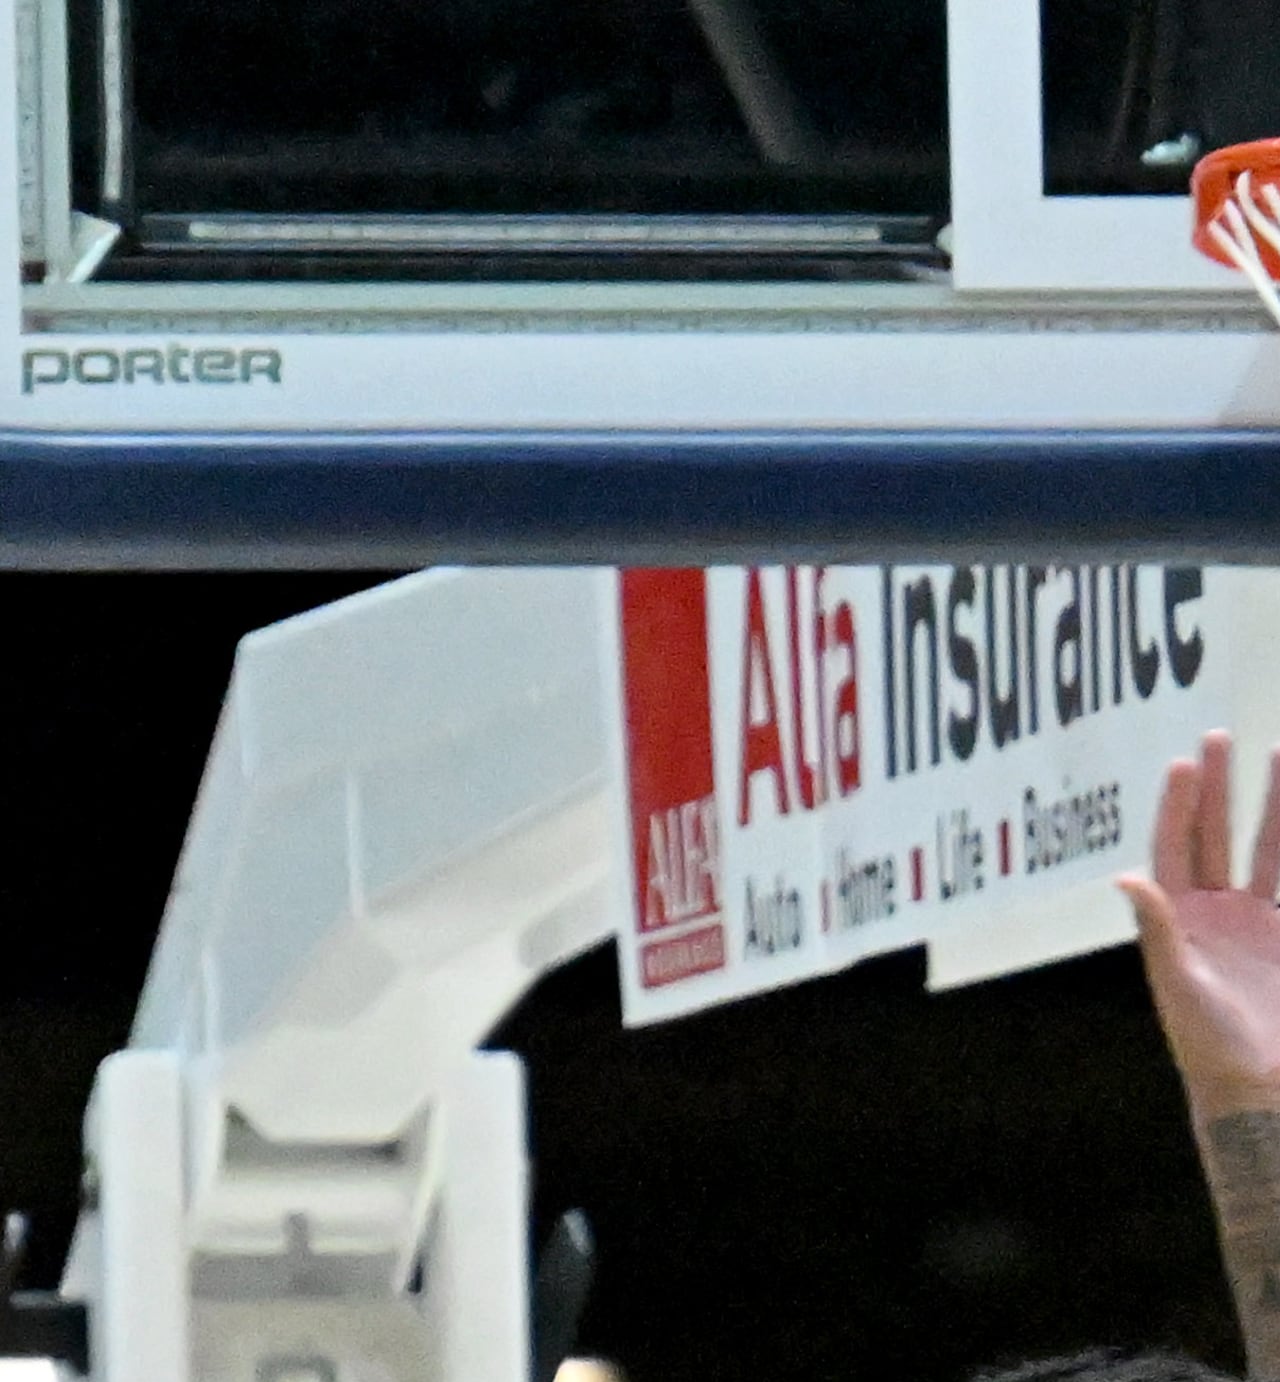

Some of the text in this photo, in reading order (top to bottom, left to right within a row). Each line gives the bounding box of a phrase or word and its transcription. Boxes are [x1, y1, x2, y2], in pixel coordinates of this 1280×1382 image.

[739, 566, 1205, 828] Alfa Insurance
[743, 874, 803, 958] Auto
[834, 845, 896, 931] Home
[936, 808, 985, 900] Life
[1023, 780, 1122, 875] Business
